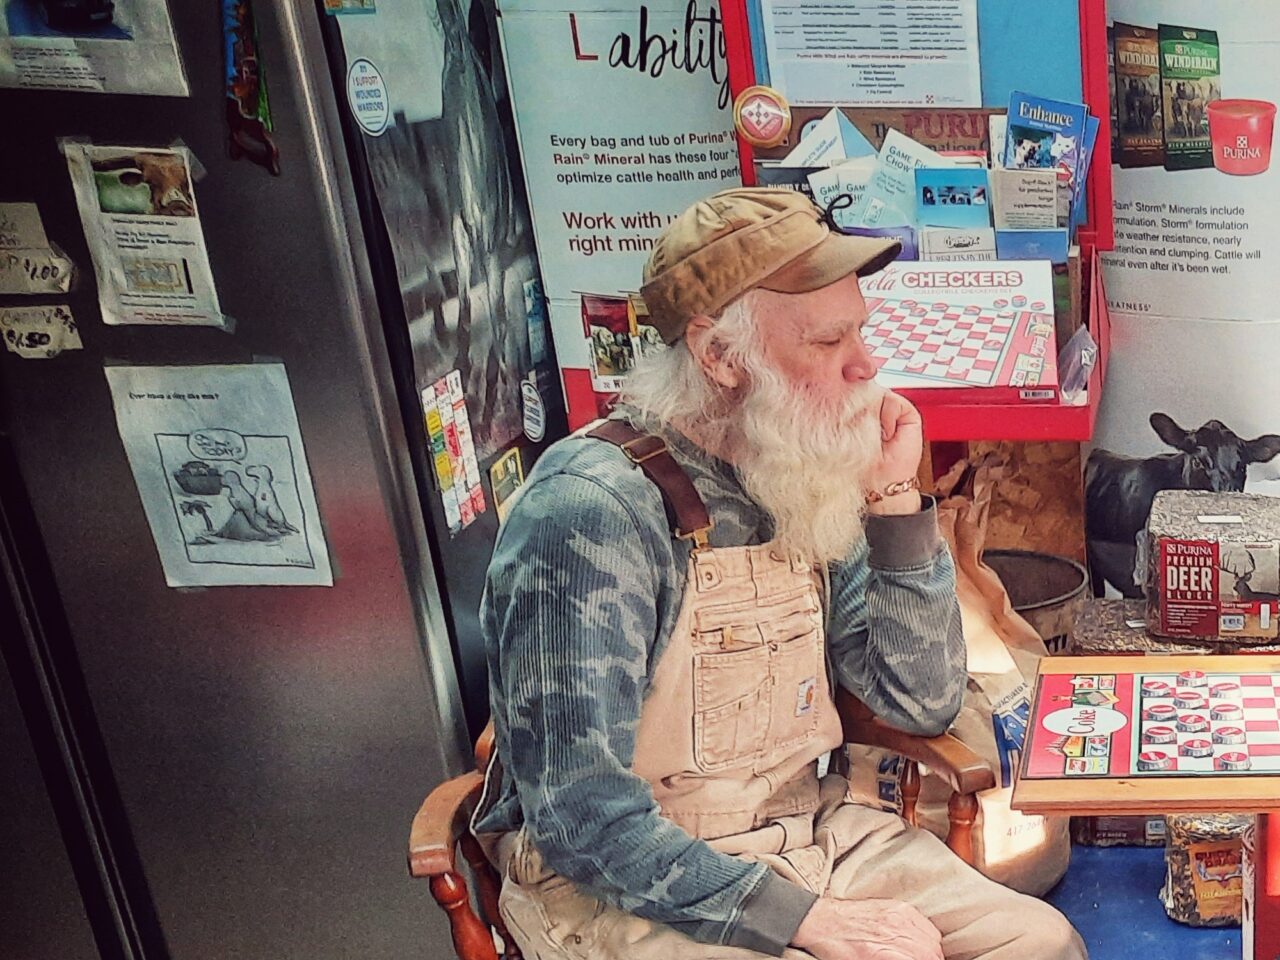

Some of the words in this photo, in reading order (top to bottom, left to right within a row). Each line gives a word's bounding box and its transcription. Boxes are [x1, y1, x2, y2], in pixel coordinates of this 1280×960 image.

[1019, 101, 1074, 127] Enhance
[550, 134, 586, 149] Every
[591, 135, 616, 149] bag
[620, 135, 645, 147] and
[649, 134, 670, 146] tub
[674, 133, 686, 145] of
[595, 153, 645, 165] Mineral
[649, 152, 672, 164] has
[675, 151, 707, 163] these
[710, 149, 729, 162] four
[889, 145, 912, 163] GAME
[1223, 147, 1261, 160] PURINA
[556, 171, 612, 185] optimize
[616, 171, 653, 183] cattle
[657, 169, 694, 182] health
[698, 168, 718, 180] and
[1169, 204, 1207, 216] Minerals
[1210, 205, 1245, 216] include
[563, 212, 616, 229] Work
[621, 211, 661, 229] with
[1113, 217, 1158, 228] ormulation.
[1195, 220, 1249, 231] formulation
[569, 234, 613, 256] right
[1126, 231, 1159, 242] weather
[1162, 233, 1211, 245] resistance,
[1213, 236, 1242, 247] nearly
[1150, 247, 1166, 256] and
[1214, 249, 1243, 260] Cattle
[1245, 249, 1261, 260] will
[1127, 260, 1148, 270] even
[1150, 261, 1169, 271] after
[1171, 262, 1185, 272] it's
[1186, 264, 1209, 273] been
[902, 271, 1023, 289] CHECKERS
[1177, 544, 1213, 556] PURINA
[1166, 555, 1213, 566] PREMIUM
[1166, 566, 1213, 592] DEER
[1067, 709, 1097, 734] Coke
